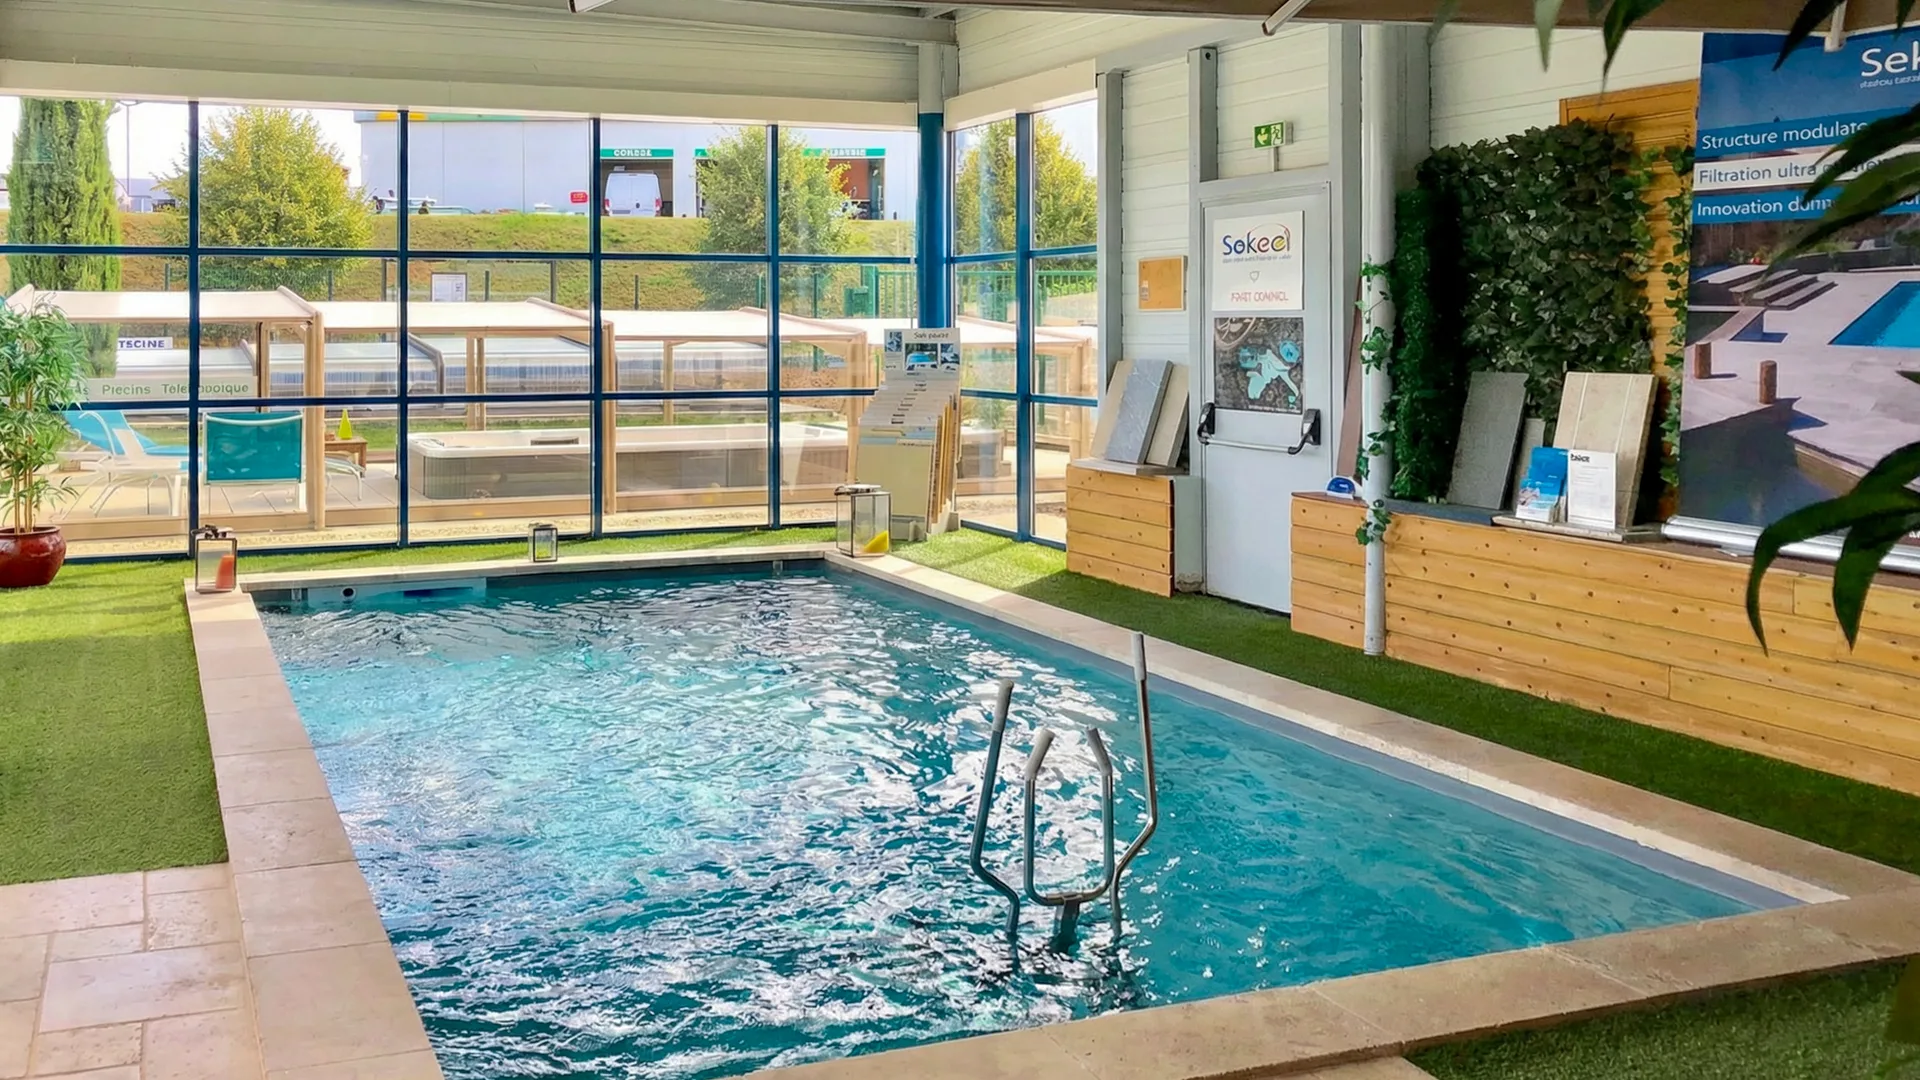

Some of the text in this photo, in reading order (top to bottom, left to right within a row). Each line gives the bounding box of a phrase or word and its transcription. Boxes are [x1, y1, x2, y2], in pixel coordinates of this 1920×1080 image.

[1701, 131, 1778, 150] Structure
[1699, 166, 1772, 184] Filtration
[1777, 162, 1817, 178] ultra
[1696, 199, 1784, 217] Innovation
